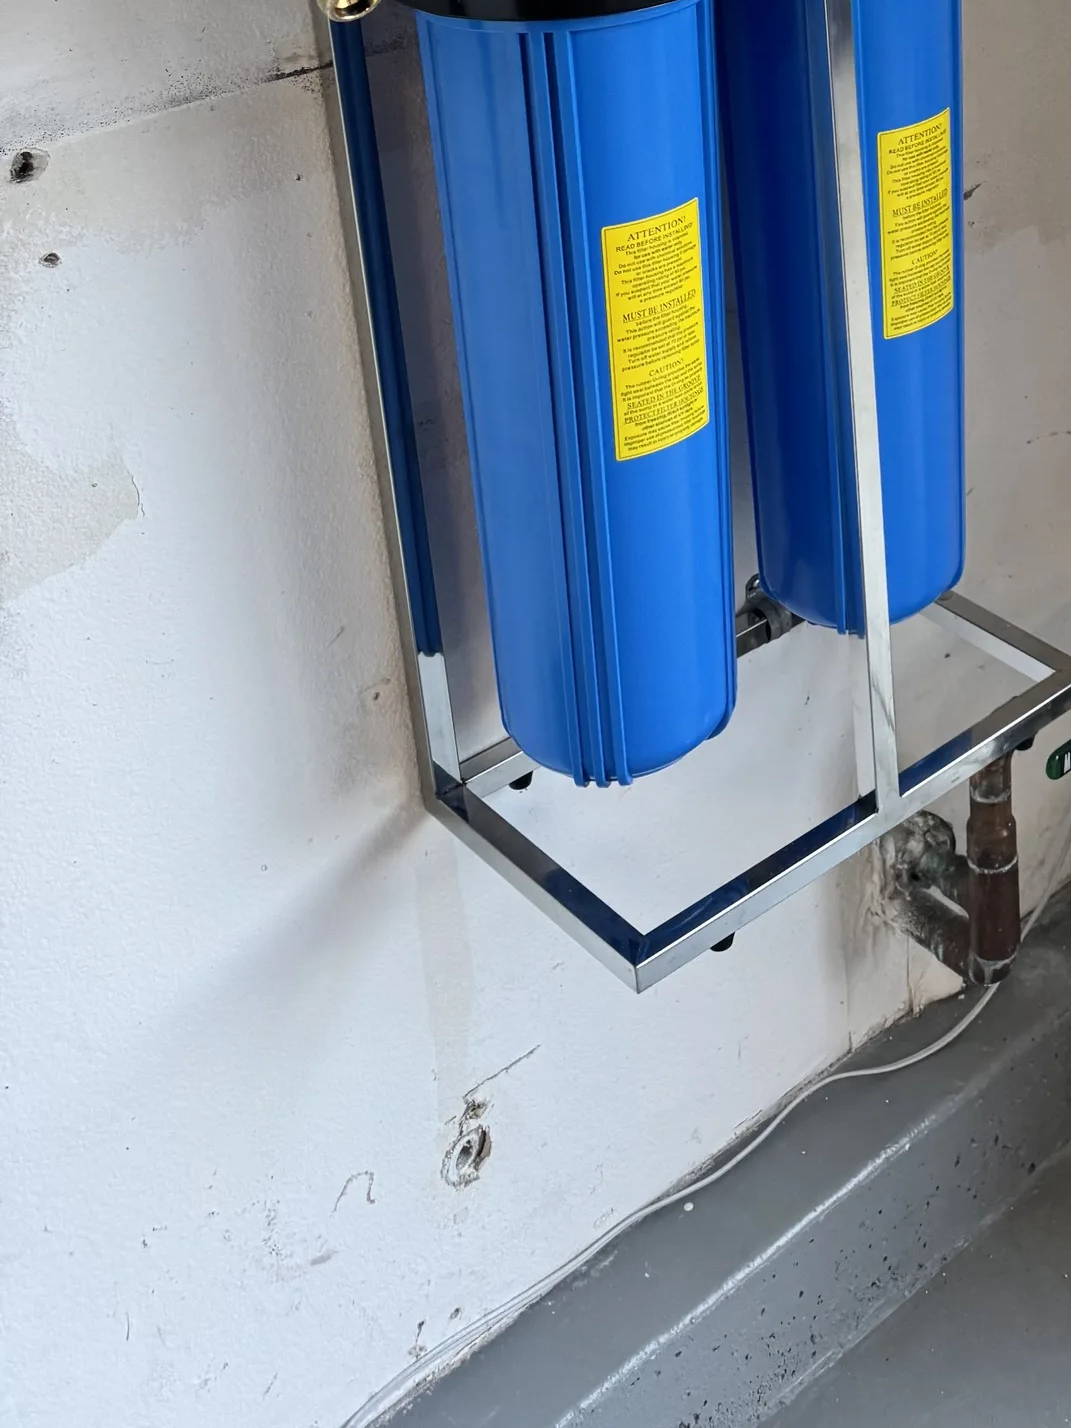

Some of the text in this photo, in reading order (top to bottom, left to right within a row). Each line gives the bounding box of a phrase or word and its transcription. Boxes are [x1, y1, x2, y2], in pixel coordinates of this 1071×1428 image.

[628, 216, 685, 241] ATTENTION!
[616, 244, 635, 252] READ
[636, 236, 661, 247] BEFORE
[623, 289, 696, 323] MUST BE INSTALLED
[627, 396, 655, 410] SEATED
[624, 410, 657, 424] PROTECT
